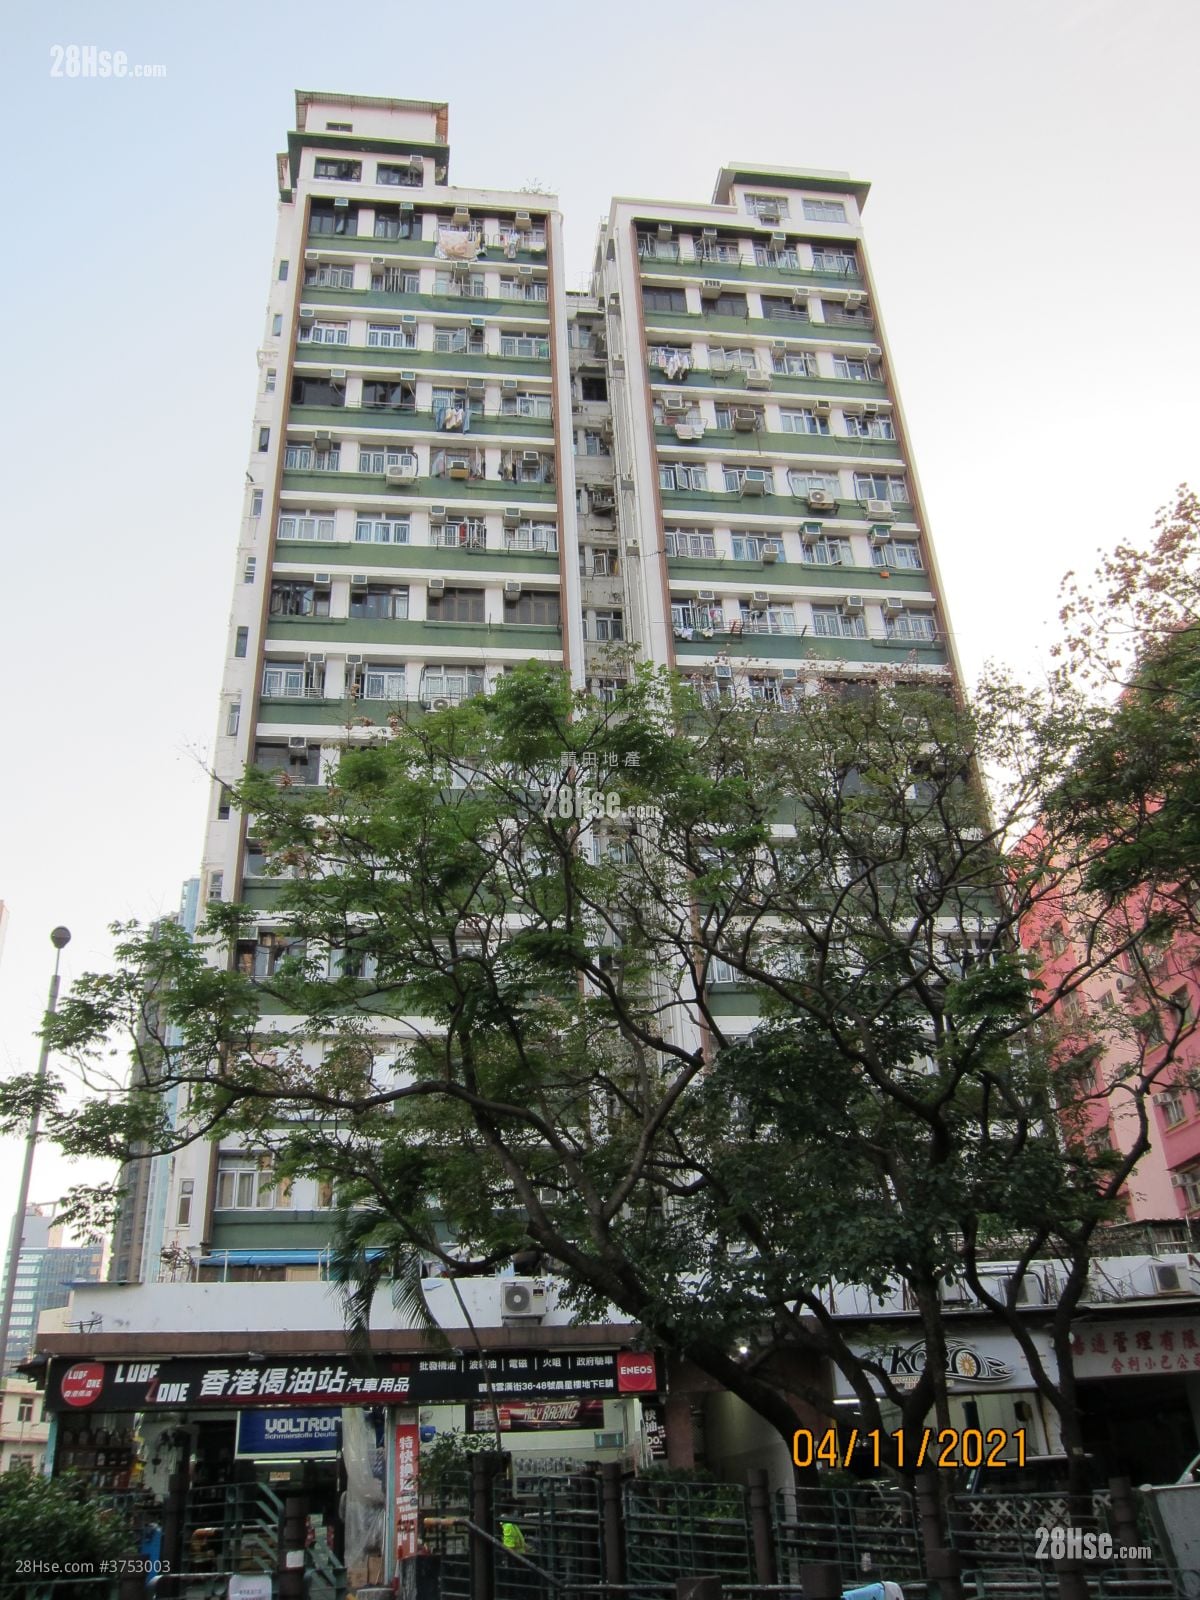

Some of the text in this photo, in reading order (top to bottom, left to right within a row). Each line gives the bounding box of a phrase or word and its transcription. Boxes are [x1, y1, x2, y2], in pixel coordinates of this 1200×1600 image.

[620, 1365, 653, 1375] ENEOS
[200, 1366, 410, 1397] 香港偈油站 汽車用品
